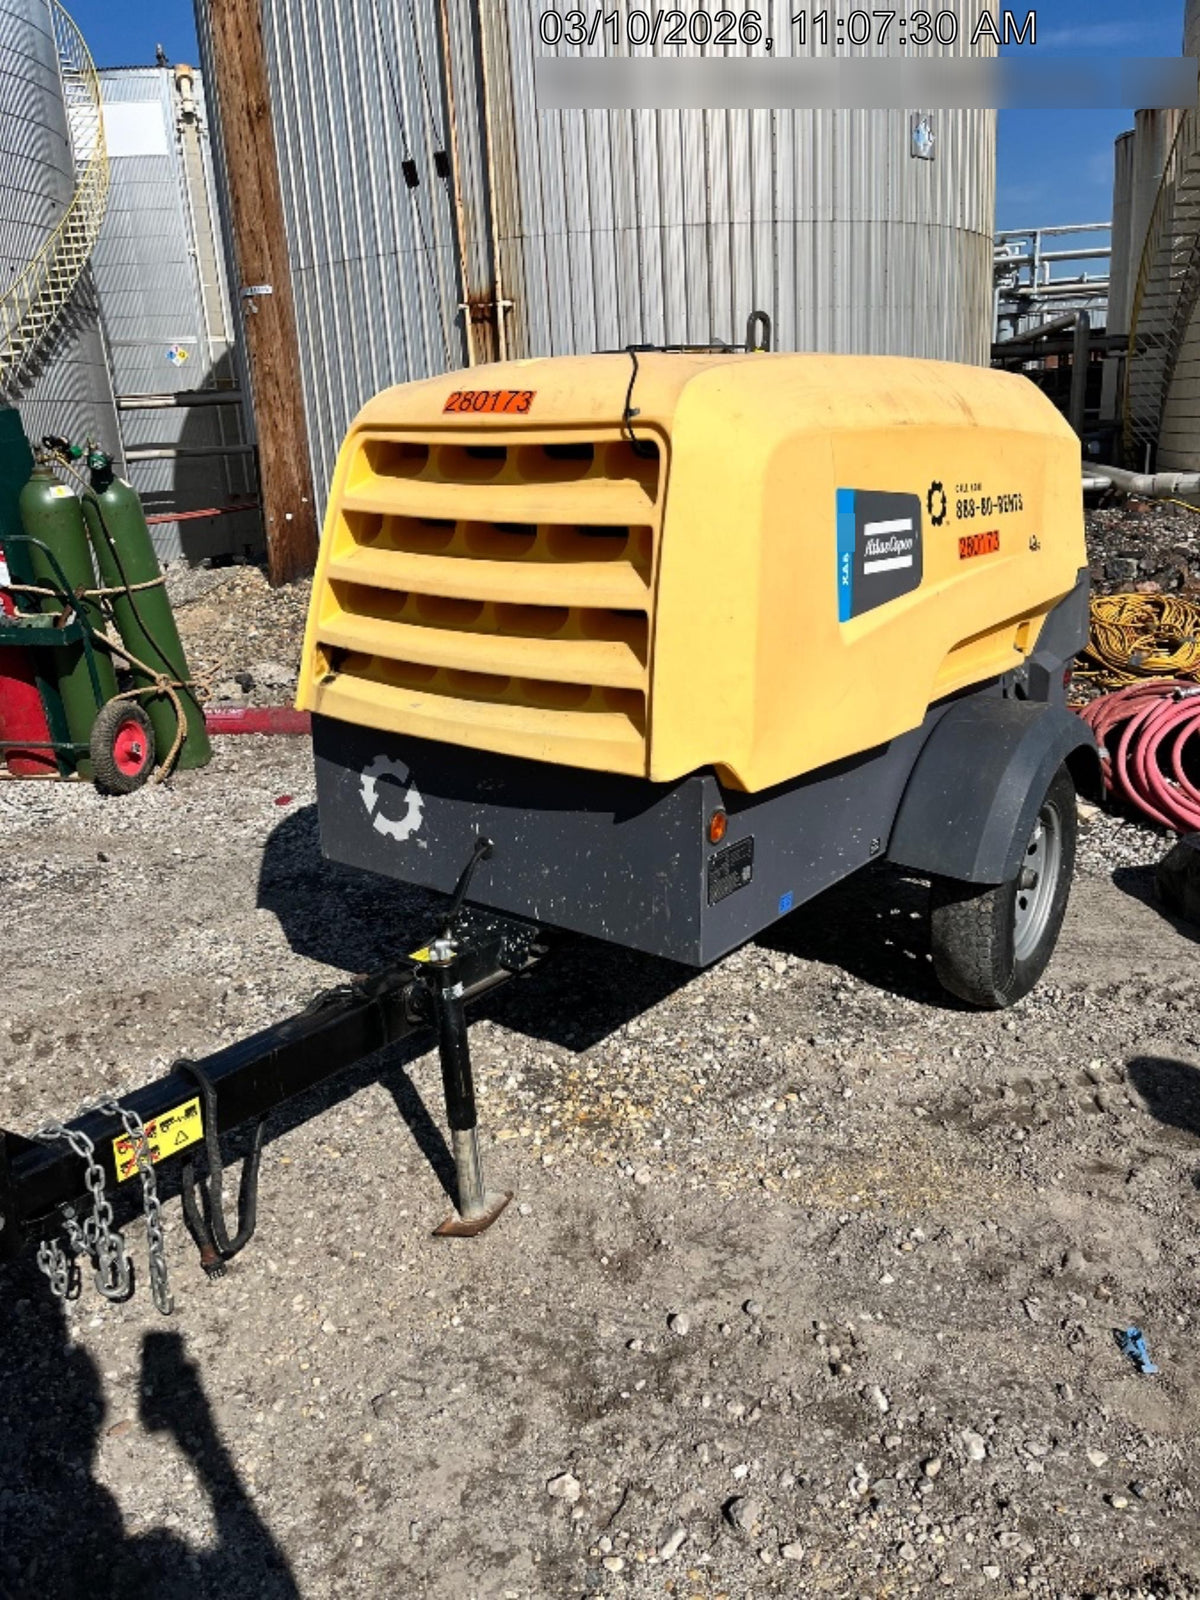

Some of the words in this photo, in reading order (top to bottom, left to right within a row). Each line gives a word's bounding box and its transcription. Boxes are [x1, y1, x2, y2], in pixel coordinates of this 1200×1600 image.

[445, 390, 533, 412] 280173
[956, 493, 1023, 519] 888-80-RENTS
[959, 530, 1000, 559] 280173
